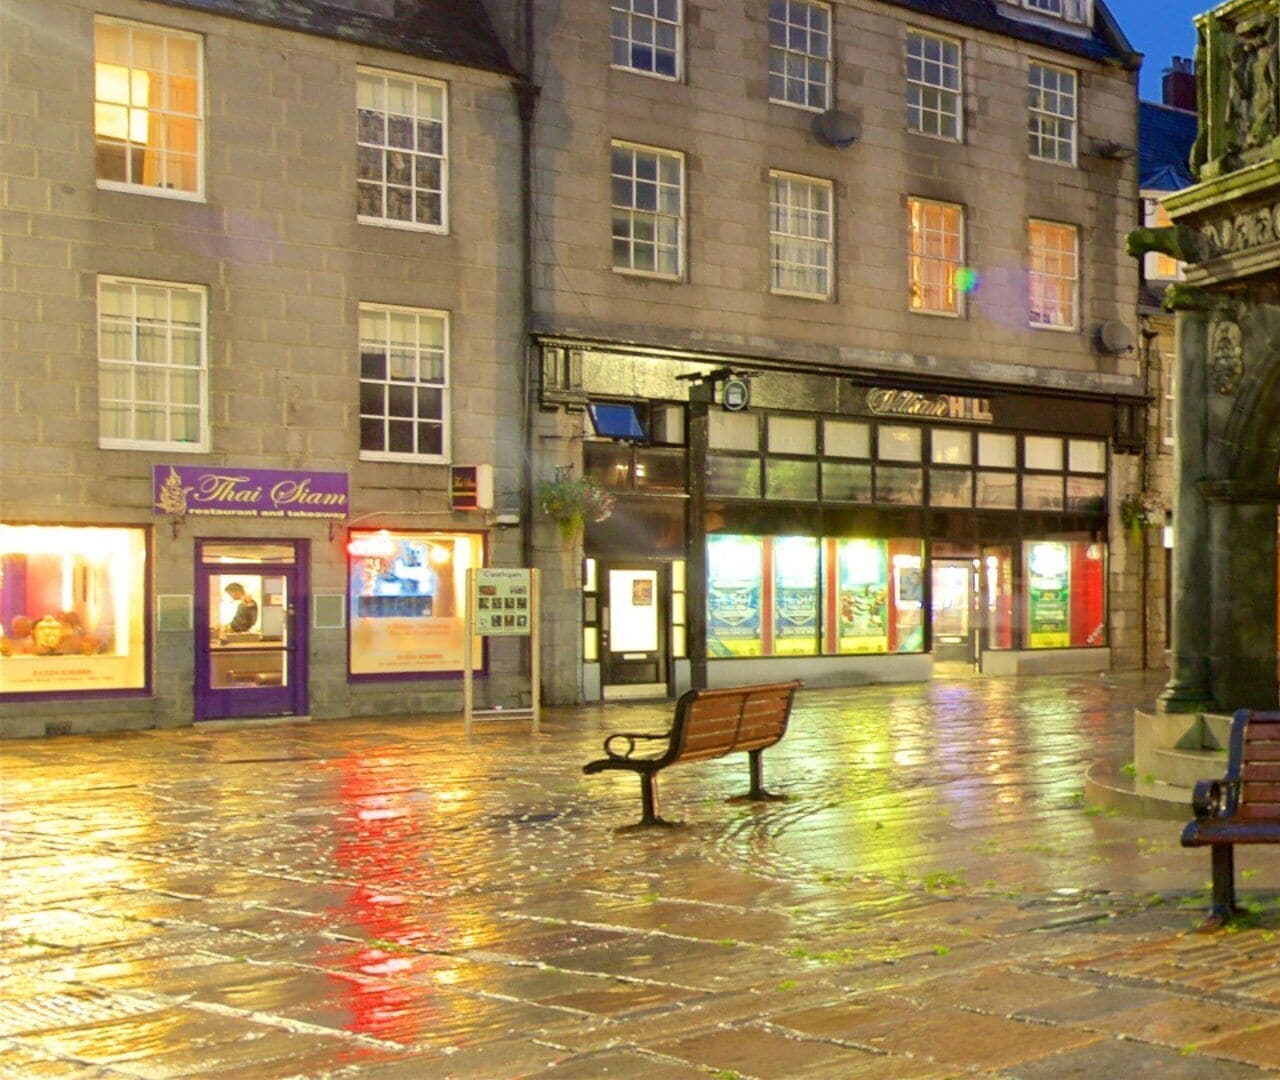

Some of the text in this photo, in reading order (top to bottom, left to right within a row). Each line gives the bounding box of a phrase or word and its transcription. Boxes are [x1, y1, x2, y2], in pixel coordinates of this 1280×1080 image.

[867, 387, 993, 422] William HILL
[194, 474, 347, 508] Thai Siam
[188, 508, 347, 520] restaurant and takeaway
